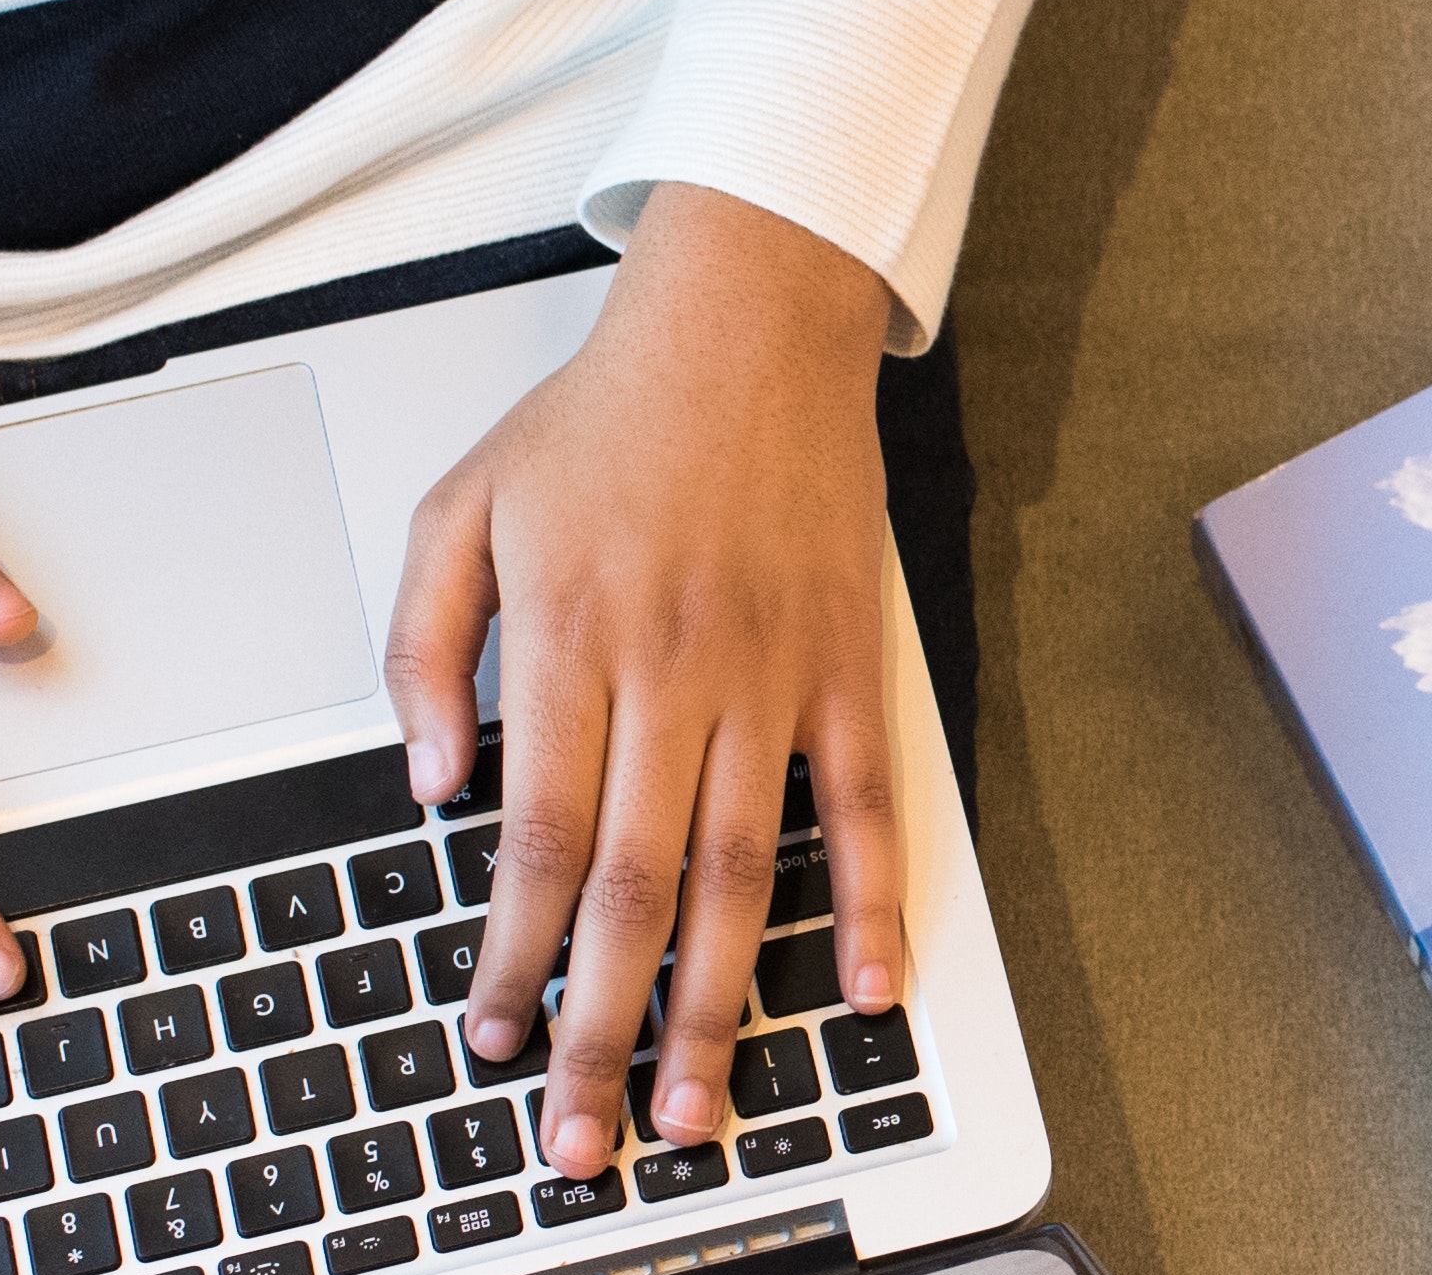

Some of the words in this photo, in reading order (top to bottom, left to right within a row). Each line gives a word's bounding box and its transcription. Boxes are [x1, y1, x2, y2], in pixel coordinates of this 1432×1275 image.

[386, 872, 404, 893] C
[289, 895, 307, 917] V
[189, 917, 207, 938] B
[88, 939, 108, 963] N
[453, 947, 472, 969] D
[358, 971, 371, 993] F
[253, 994, 274, 1016] G
[154, 1016, 176, 1040] H
[59, 1040, 69, 1061] J
[398, 1053, 415, 1075] R
[302, 1078, 315, 1100] T
[200, 1101, 216, 1123] Y
[873, 1114, 900, 1129] esc
[96, 1123, 117, 1147] U
[465, 1119, 480, 1138] 4
[364, 1141, 378, 1162] 5
[745, 1139, 756, 1149] F1
[472, 1147, 486, 1167] $
[263, 1165, 278, 1186] 6
[645, 1163, 658, 1174] F2
[366, 1171, 389, 1191] %
[166, 1188, 180, 1210] 7
[540, 1187, 554, 1198] F3
[61, 1213, 76, 1234] 8
[167, 1219, 185, 1238] &
[437, 1213, 450, 1224] F4
[332, 1237, 345, 1249] F5
[227, 1263, 241, 1273] F6
